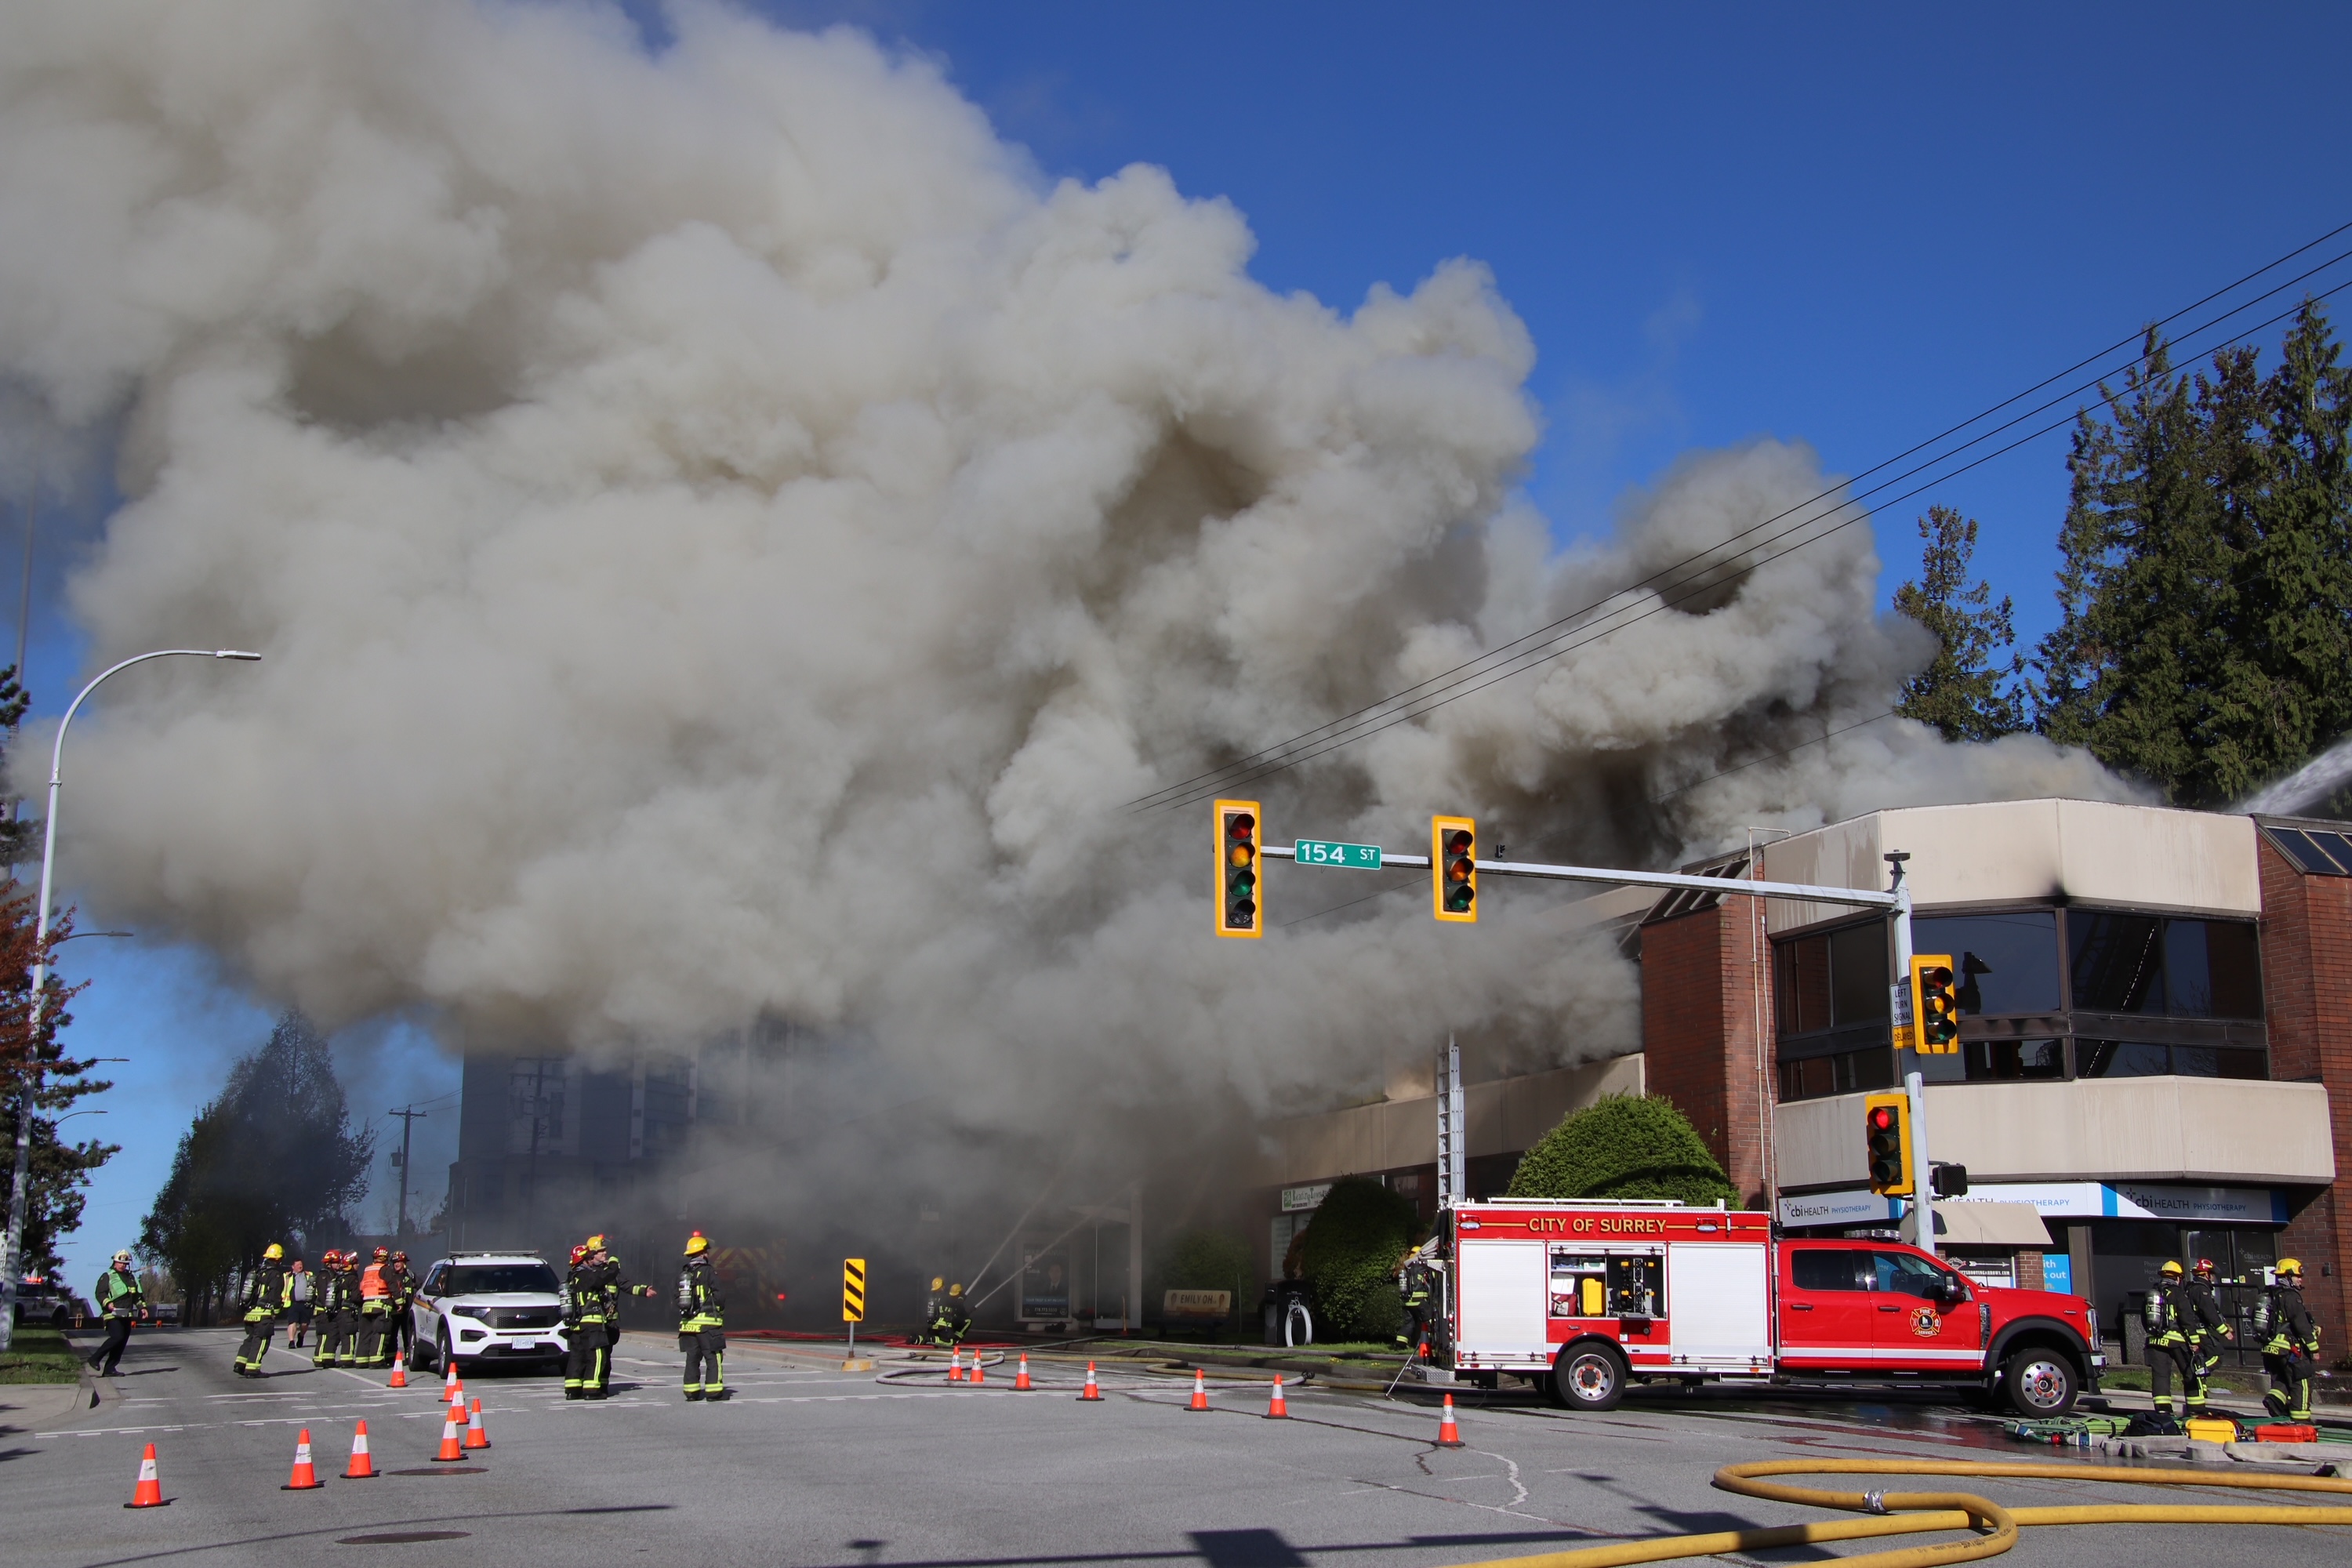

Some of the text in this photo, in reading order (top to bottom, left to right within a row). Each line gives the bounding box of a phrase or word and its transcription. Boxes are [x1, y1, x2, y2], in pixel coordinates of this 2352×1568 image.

[1301, 844, 1376, 863] 154 ST
[1894, 988, 1907, 998] LEFT
[1894, 1000, 1908, 1009] TURN
[1893, 1011, 1911, 1022] SIGNAL
[1894, 1032, 1913, 1042] DELAYED
[2135, 1195, 2246, 1212] cbi HEALTH PHYSIOTHERAPY
[1791, 1204, 1871, 1218] cbi HEALTH PHYSIOTHERAPY
[1529, 1218, 1667, 1232] CITY OF SURREY
[2042, 1259, 2056, 1269] ith
[1180, 1294, 1214, 1305] EMILY OH
